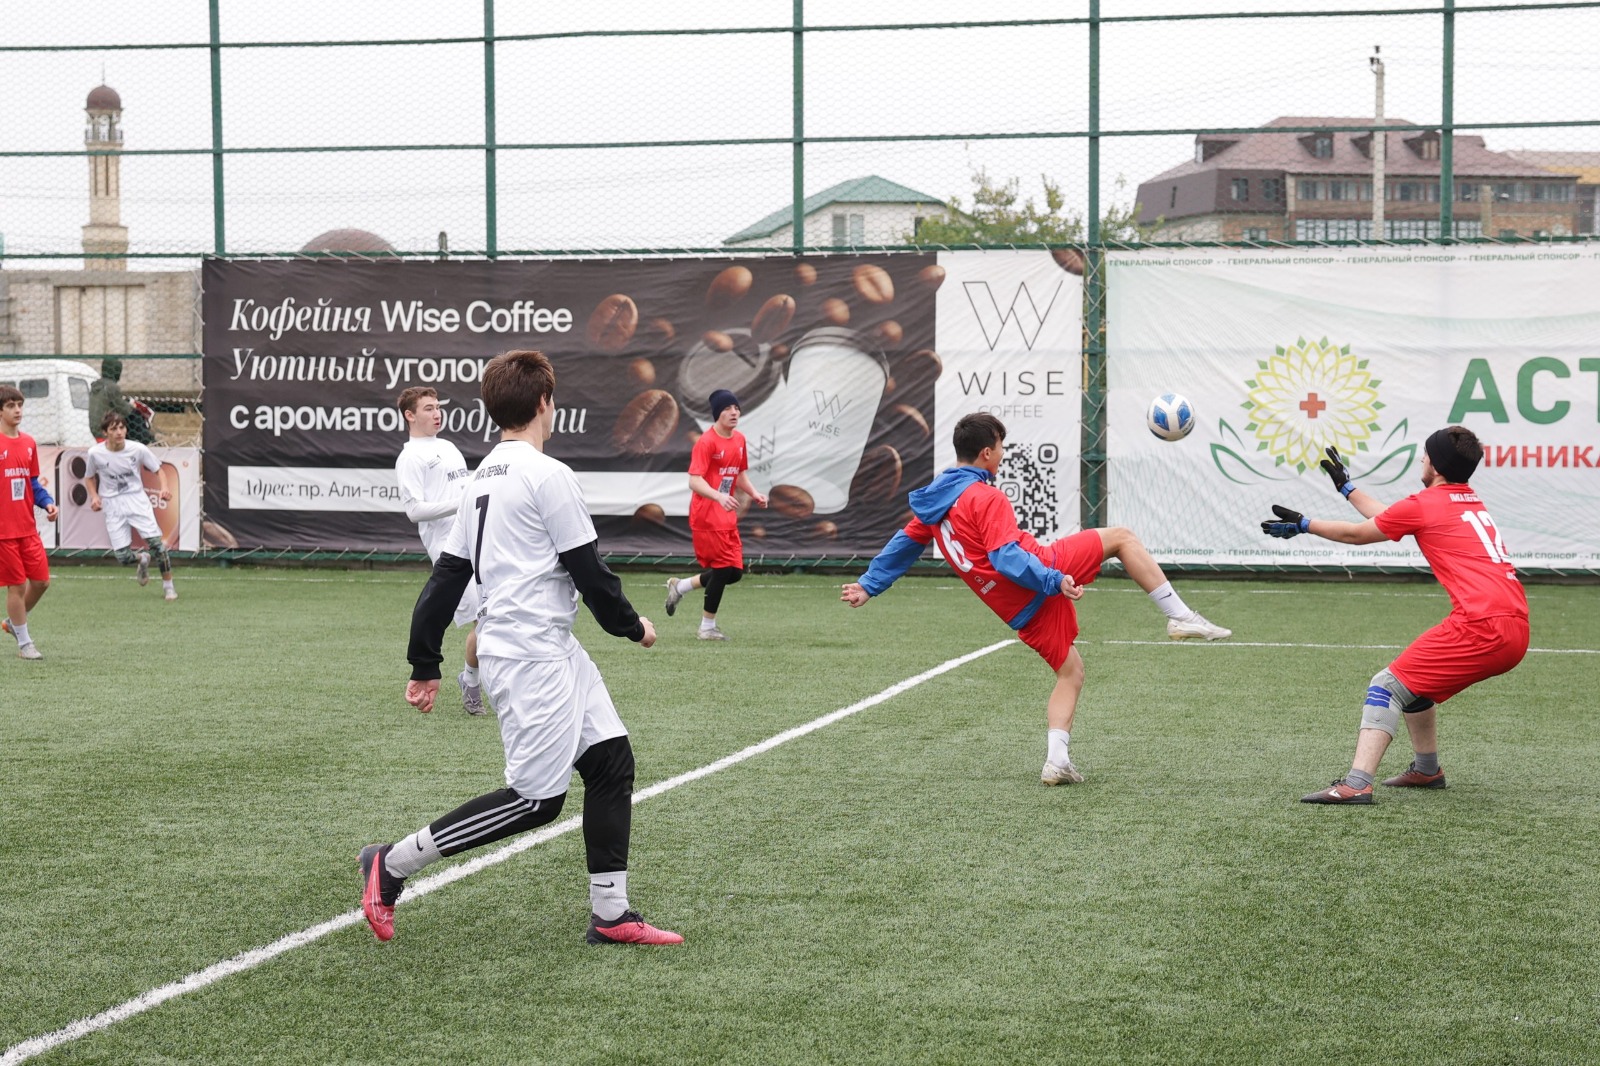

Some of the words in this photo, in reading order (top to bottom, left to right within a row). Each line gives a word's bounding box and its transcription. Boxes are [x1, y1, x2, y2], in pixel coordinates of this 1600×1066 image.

[1109, 258, 1171, 267] ГЕНЕРАЛЬНЫЙ
[1173, 258, 1213, 266] СПОНСОР
[1228, 257, 1291, 266] ГЕНЕРАЛЬНЫЙ
[1293, 257, 1334, 265] СПОНСОР
[1347, 254, 1411, 264] ГЕНЕРАЛЬНЫЙ
[1413, 255, 1456, 263] СПОНСОР
[1469, 252, 1535, 262] ГЕНЕРАЛЬНЫЙ
[1537, 253, 1580, 261] СПОНСОР
[228, 297, 371, 341] Кофейня
[380, 300, 461, 332] Wise
[466, 300, 573, 333] Coffee
[230, 348, 376, 382] Уютный
[958, 371, 1064, 395] WISE
[230, 405, 249, 429] с
[1484, 445, 1600, 468] ИНИК
[241, 479, 294, 501] Адрес:
[299, 484, 323, 500] пр.
[475, 494, 490, 585] 1
[940, 519, 974, 573] 6
[1460, 510, 1512, 564] 12
[1174, 547, 1214, 556] СПОНСОР
[1228, 548, 1291, 557] ГЕНЕРАЛЬНЫЙ
[1293, 549, 1334, 558] СПОНСОР
[1347, 549, 1411, 558] ГЕНЕРАЛЬНЫЙ
[1535, 552, 1577, 560] СПОНСОР
